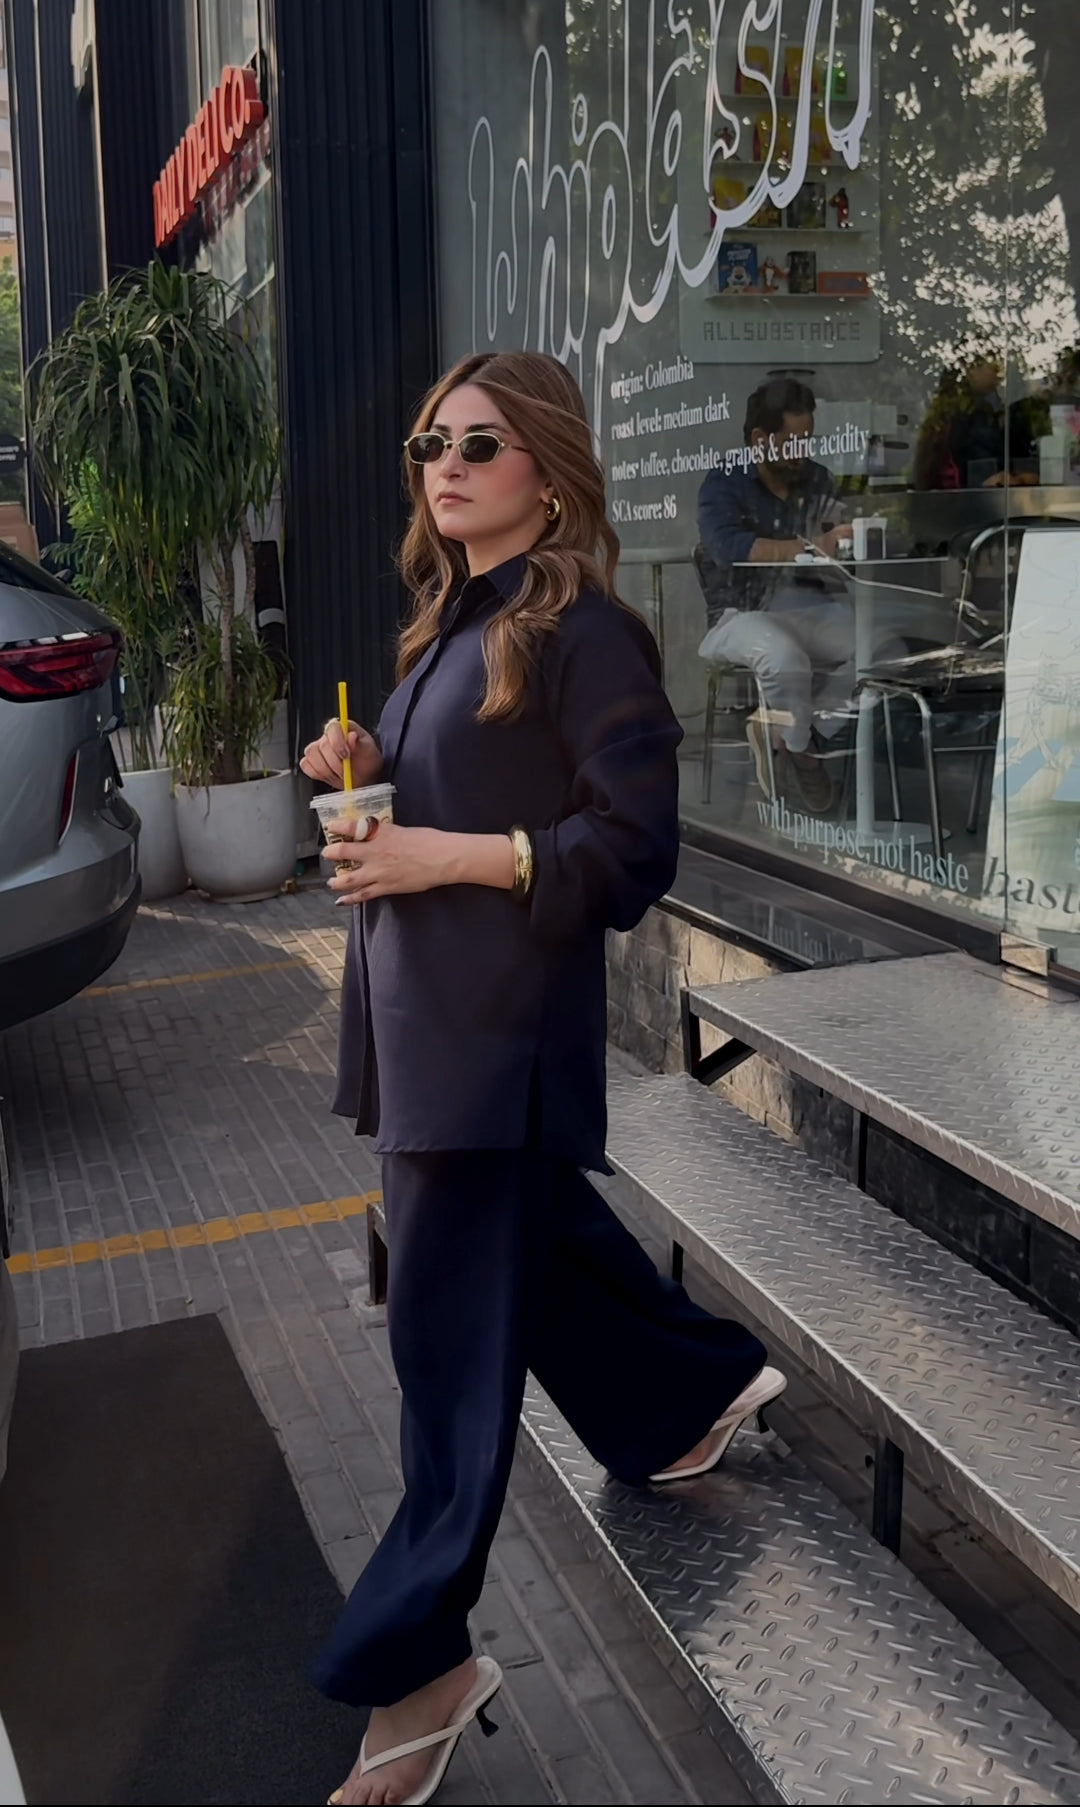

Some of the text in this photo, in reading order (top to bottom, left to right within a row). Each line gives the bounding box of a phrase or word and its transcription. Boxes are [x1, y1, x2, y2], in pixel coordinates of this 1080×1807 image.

[153, 65, 251, 248] DAILY DELI CO.
[703, 321, 861, 341] ALLSUBSTANCE
[611, 355, 694, 404] origin: Colombia
[611, 393, 731, 440] roast level: medium dark
[640, 451, 670, 478] toffee,
[671, 445, 724, 472] chocolate,
[725, 441, 765, 476] grapes
[767, 433, 779, 462] &
[782, 431, 817, 460] citric
[819, 422, 870, 460] acidity
[612, 494, 677, 522] SCA score: 86
[757, 796, 969, 893] with purpose, not haste
[983, 856, 1080, 914] hast
